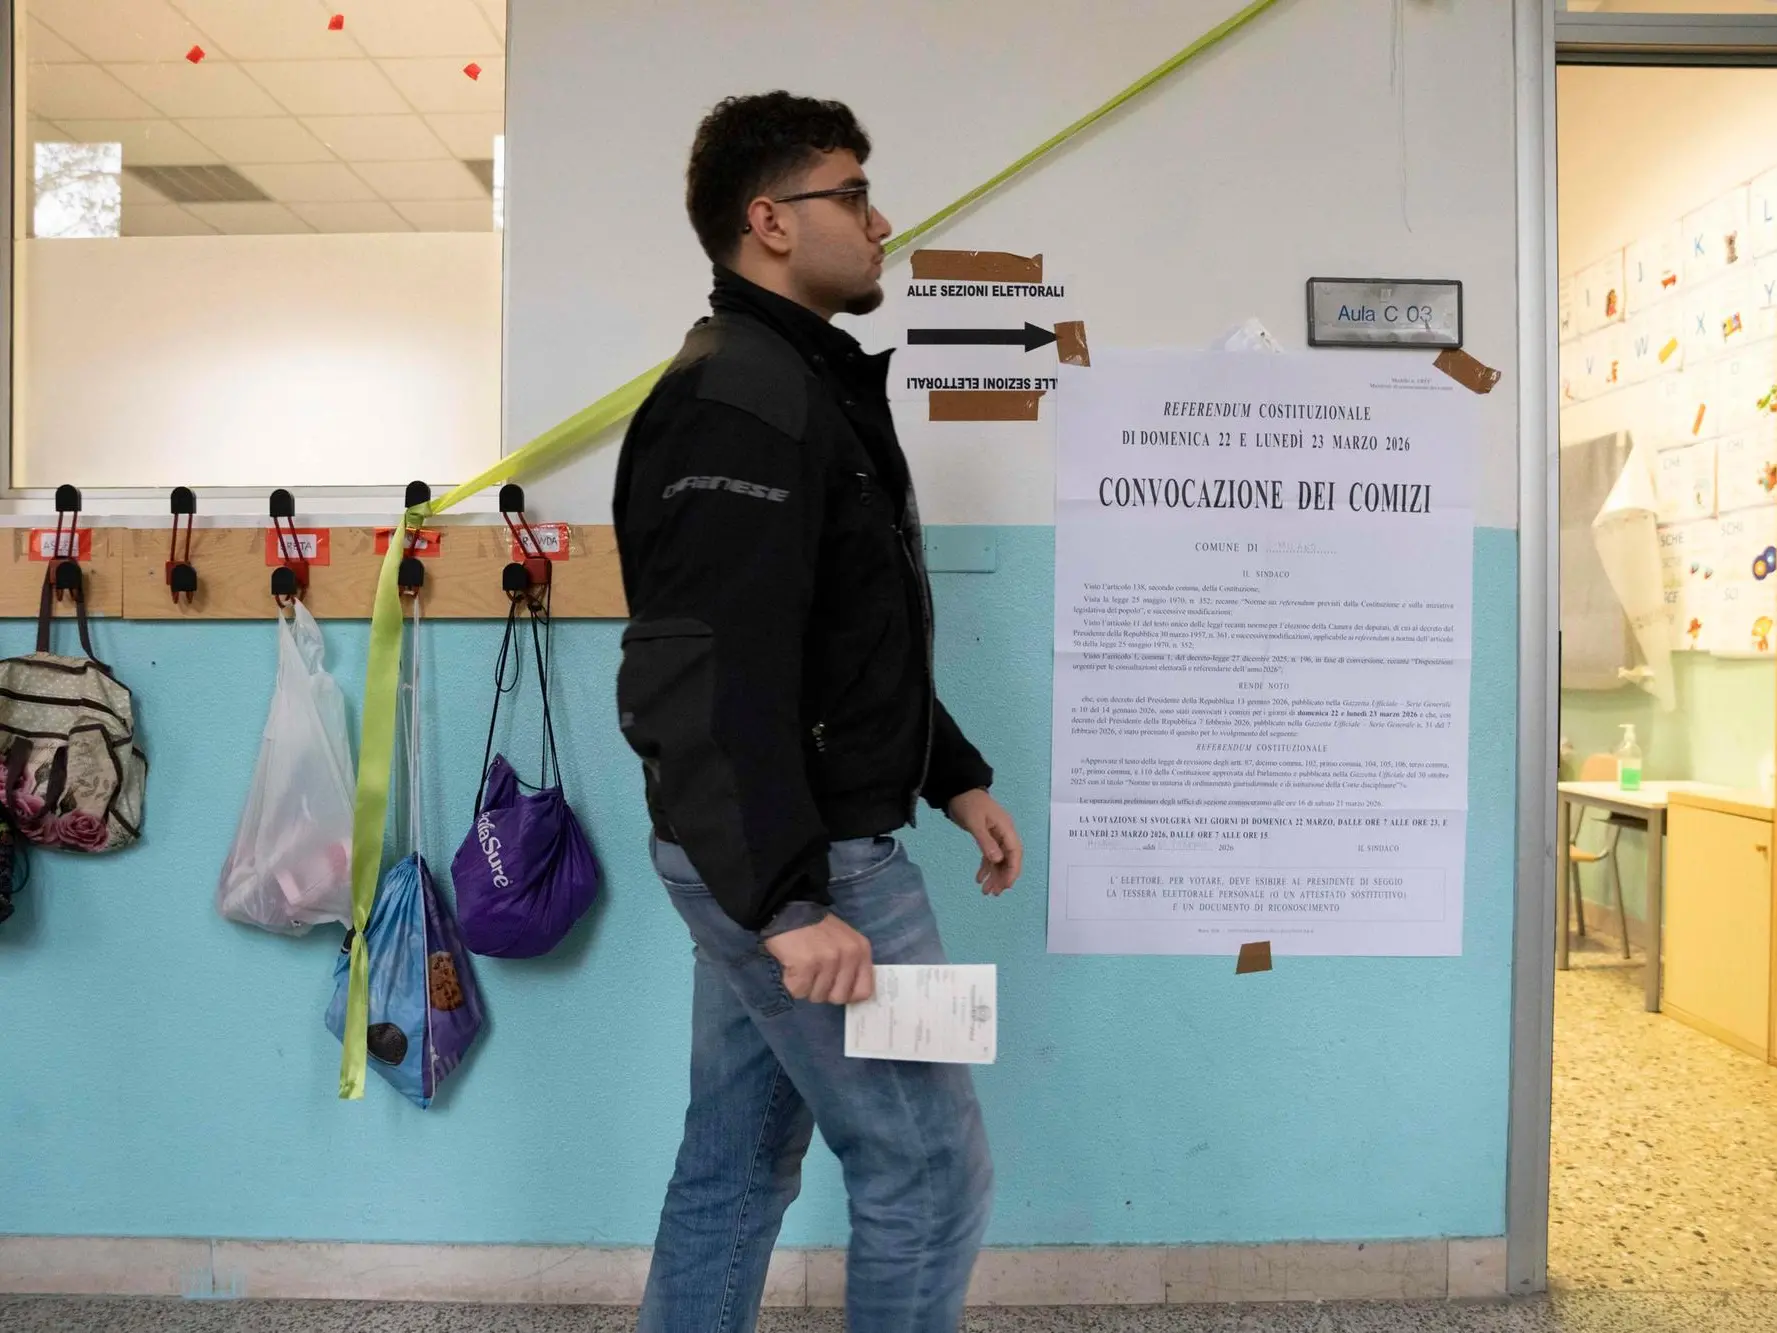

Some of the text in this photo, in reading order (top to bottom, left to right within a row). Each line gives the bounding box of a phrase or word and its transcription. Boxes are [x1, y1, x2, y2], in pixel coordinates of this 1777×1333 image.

[1694, 233, 1705, 258] K
[907, 285, 1064, 298] ALLE SEZIONI ELETTORALI
[1338, 304, 1433, 323] Aula C 03
[1696, 311, 1706, 336] X
[907, 377, 1058, 390] LLE SEZIONI ELETTORALI
[1163, 401, 1371, 420] REFERENDUM COSTITUZIONALE
[1122, 429, 1410, 451] DI DOMENICA 22 E LUNEDÌ 23 MARZO 2026
[1099, 476, 1431, 513] CONVOCAZIONE DEI COMIZI
[522, 536, 558, 546] RWDA
[1194, 542, 1258, 552] COMUNE DI
[1255, 570, 1290, 578] SINDACO
[1238, 681, 1263, 689] RENDE
[1296, 708, 1329, 716] domenica
[1196, 743, 1326, 752] REFERENDUM COSTITUZIONALE
[1092, 816, 1137, 824] VOTAZIONE
[1139, 816, 1148, 824] SI
[1149, 815, 1191, 824] SVOLGERÀ
[1251, 817, 1292, 825] DOMENICA
[1295, 817, 1303, 825] 22
[1305, 817, 1335, 826] MARZO,
[1390, 818, 1409, 826] ALLE
[1411, 818, 1428, 826] ORE
[1079, 828, 1108, 837] LUNEDÌ
[1169, 830, 1195, 838] DALLE
[1196, 830, 1212, 838] ORE
[1242, 831, 1258, 839] ORE
[1218, 843, 1234, 851] 2026
[1357, 844, 1364, 852] IL
[1366, 844, 1399, 852] SINDACO
[1168, 876, 1184, 885] PER
[1189, 876, 1225, 886] VOTARE,
[1228, 876, 1250, 885] DEVE
[1255, 876, 1286, 885] ESIBIRE
[1291, 877, 1301, 885] AL
[1306, 877, 1354, 885] PRESIDENTE
[1359, 877, 1368, 885] DI
[1373, 877, 1402, 885] SEGGIO
[1106, 889, 1116, 897] LA
[1122, 889, 1156, 897] TESSERA
[1162, 889, 1214, 897] ELETTORALE
[1218, 889, 1265, 898] PERSONALE
[1282, 889, 1295, 898] UN
[1299, 890, 1346, 898] ATTESTATO
[1182, 902, 1194, 911] UN
[1198, 902, 1250, 911] DOCUMENTO
[1254, 902, 1263, 911] DI
[1267, 902, 1339, 911] RICONOSCIMENTO
